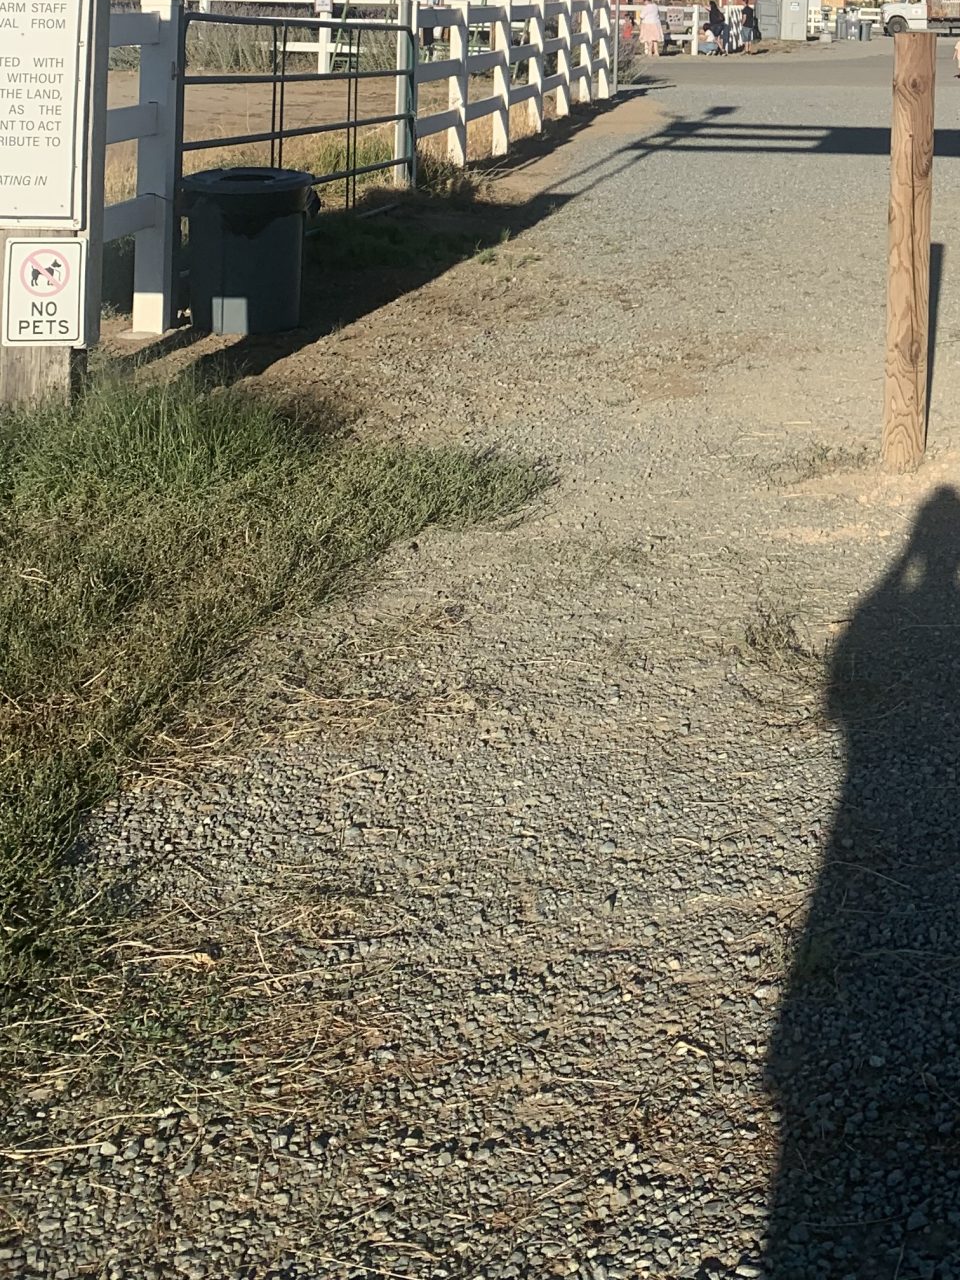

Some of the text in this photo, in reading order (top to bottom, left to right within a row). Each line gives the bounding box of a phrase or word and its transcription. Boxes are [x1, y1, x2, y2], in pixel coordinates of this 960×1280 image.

[31, 2, 68, 13] STAFF
[31, 18, 66, 29] FROM
[33, 57, 65, 68] WITH
[7, 72, 64, 84] WITHOUT
[0, 88, 63, 101] THE LAND,
[8, 104, 62, 116] AS THE
[18, 120, 35, 131] TO
[37, 120, 62, 131] ACT
[45, 136, 61, 147] TO
[34, 175, 48, 186] IN
[31, 300, 58, 317] NO
[18, 319, 70, 335] PETS
